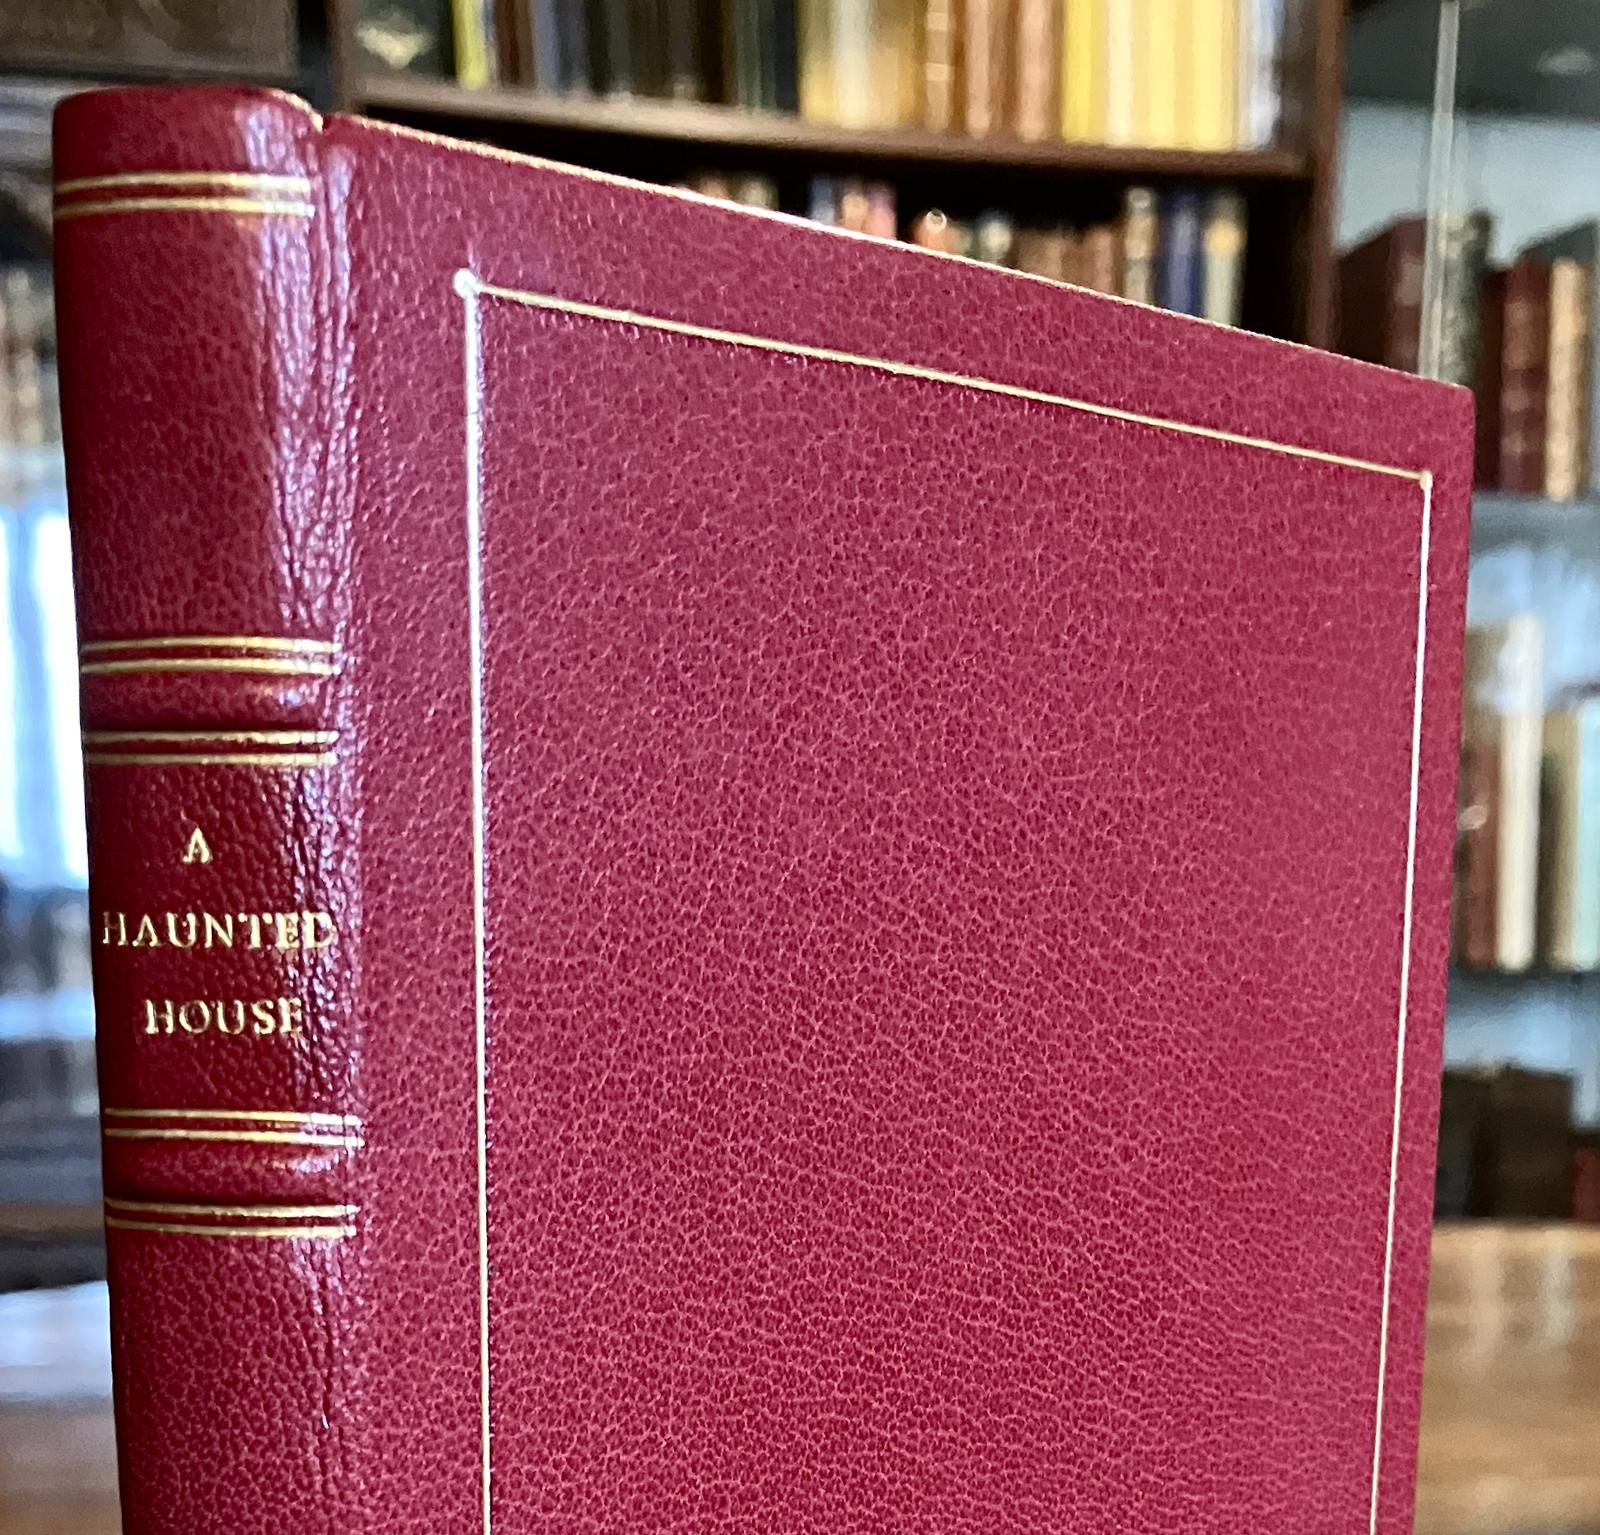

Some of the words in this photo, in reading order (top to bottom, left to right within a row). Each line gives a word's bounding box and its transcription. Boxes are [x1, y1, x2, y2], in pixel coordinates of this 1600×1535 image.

[182, 827, 214, 864] A
[102, 911, 338, 949] HAUNTED
[145, 997, 303, 1035] HOUSE
